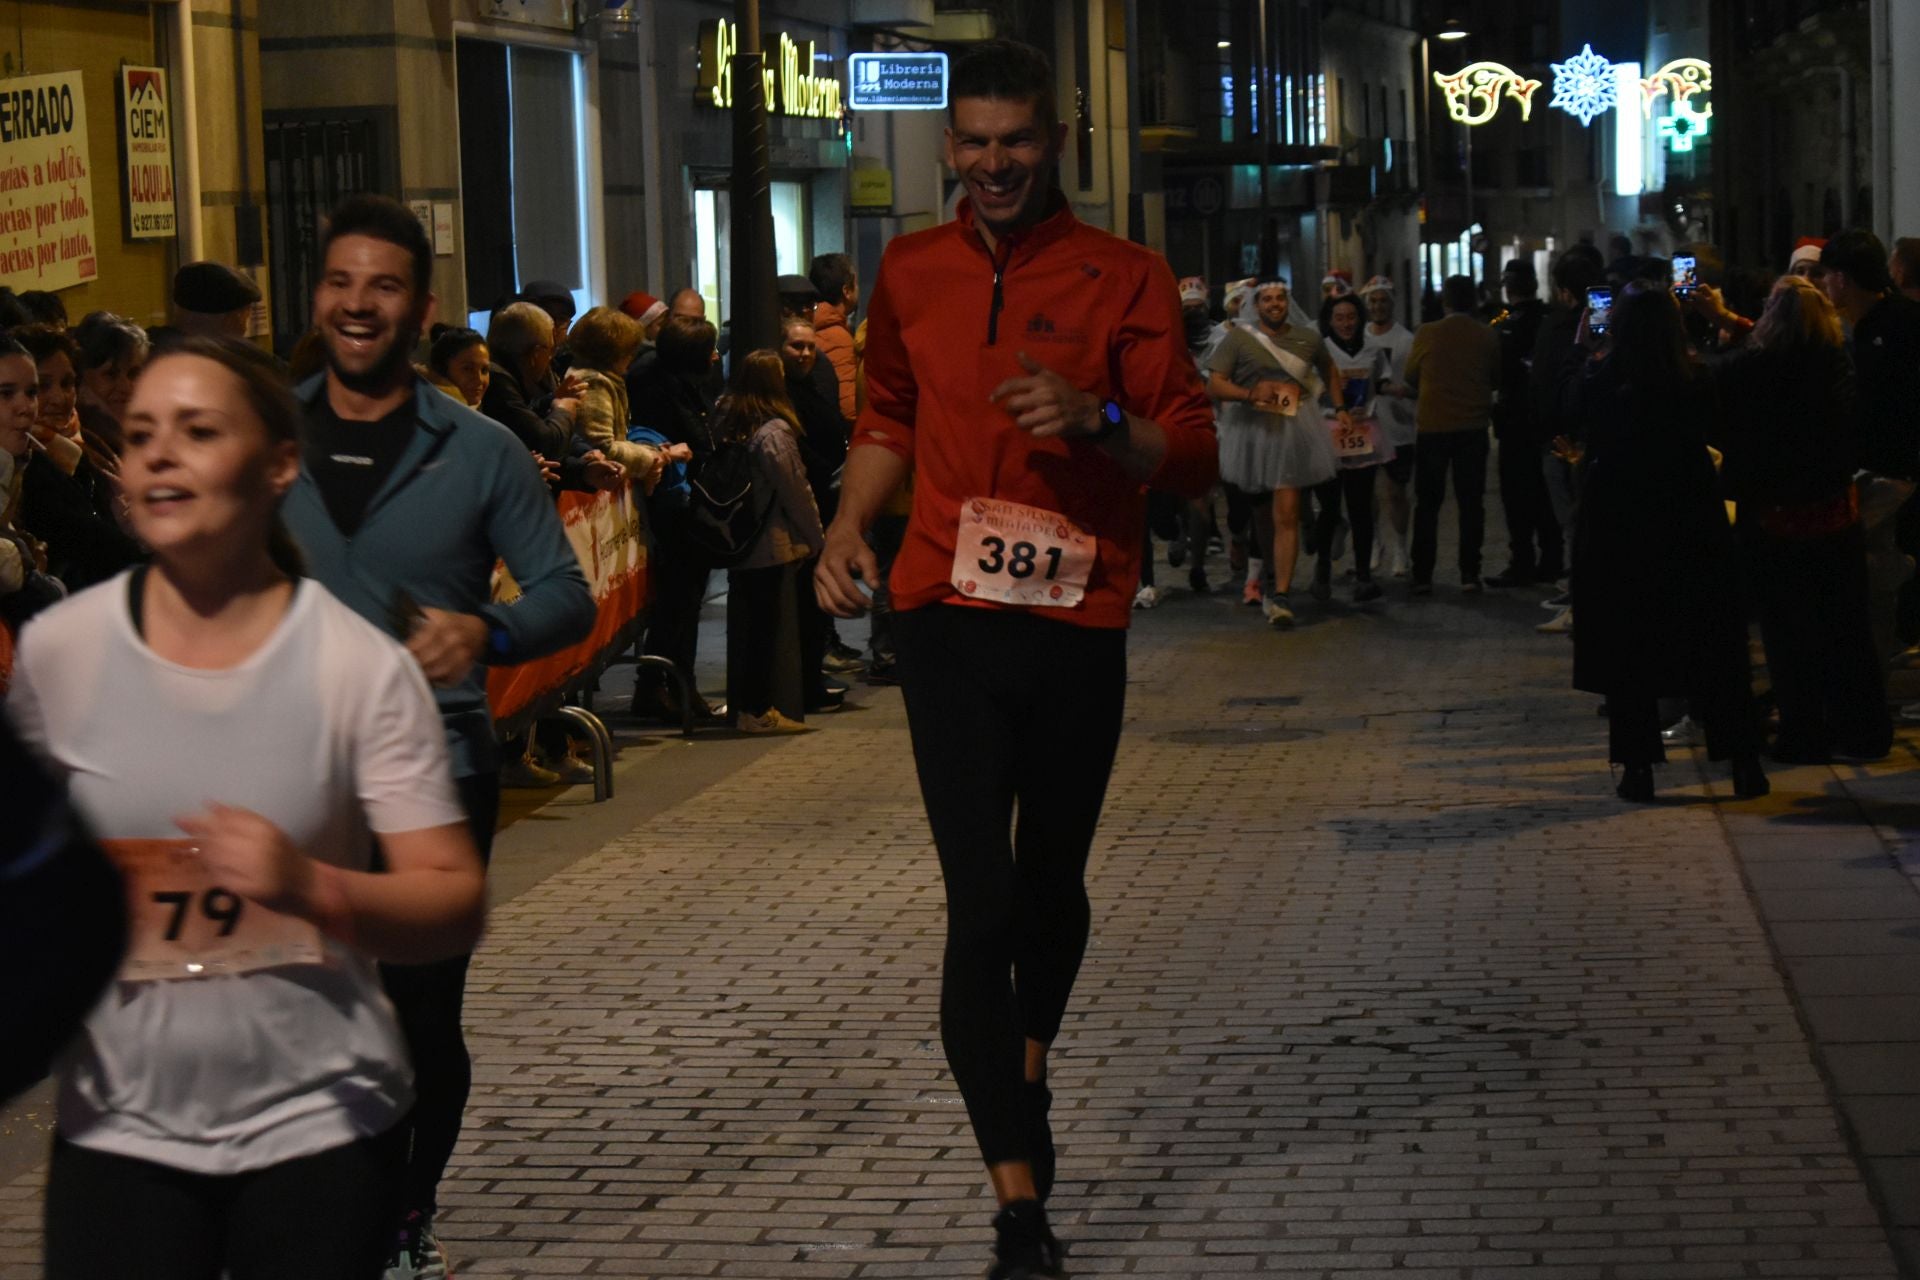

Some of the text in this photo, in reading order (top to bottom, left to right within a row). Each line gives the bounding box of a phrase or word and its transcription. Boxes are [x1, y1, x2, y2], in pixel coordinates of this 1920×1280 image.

[780, 31, 840, 119] Moderna
[881, 63, 942, 75] Librería
[883, 78, 939, 90] Moderna
[0, 84, 74, 143] ERRADO
[130, 108, 166, 139] CIEM
[34, 164, 43, 186] a
[131, 164, 173, 203] ALQUILA
[0, 188, 88, 239] acias por todo.
[0, 237, 34, 275] acias
[37, 242, 57, 278] por
[60, 230, 92, 260] tanto.
[1340, 436, 1365, 449] 155
[978, 536, 1062, 580] 381
[152, 886, 243, 942] 79
